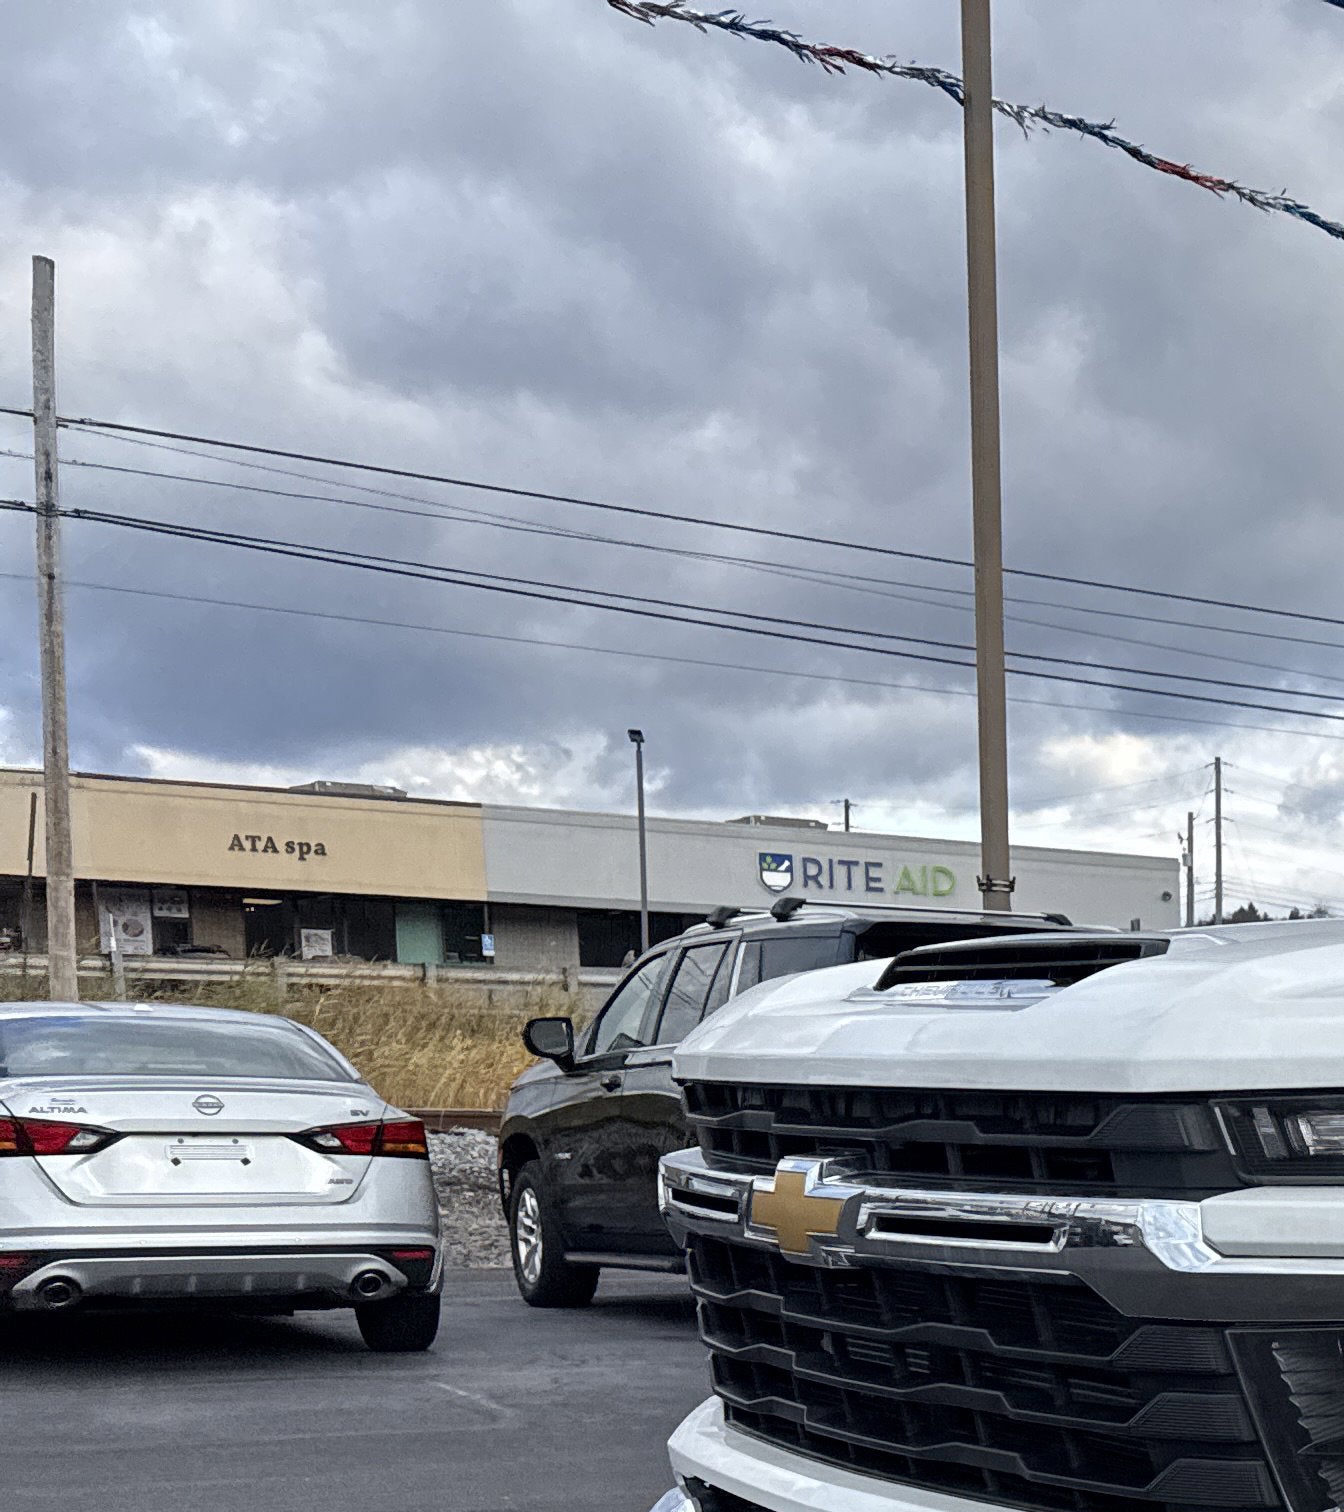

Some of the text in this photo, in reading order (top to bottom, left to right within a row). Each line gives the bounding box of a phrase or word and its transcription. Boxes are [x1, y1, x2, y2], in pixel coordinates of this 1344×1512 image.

[228, 833, 328, 861] ATA spa
[801, 856, 957, 897] RITE AID
[28, 1105, 88, 1114] ALTIMA
